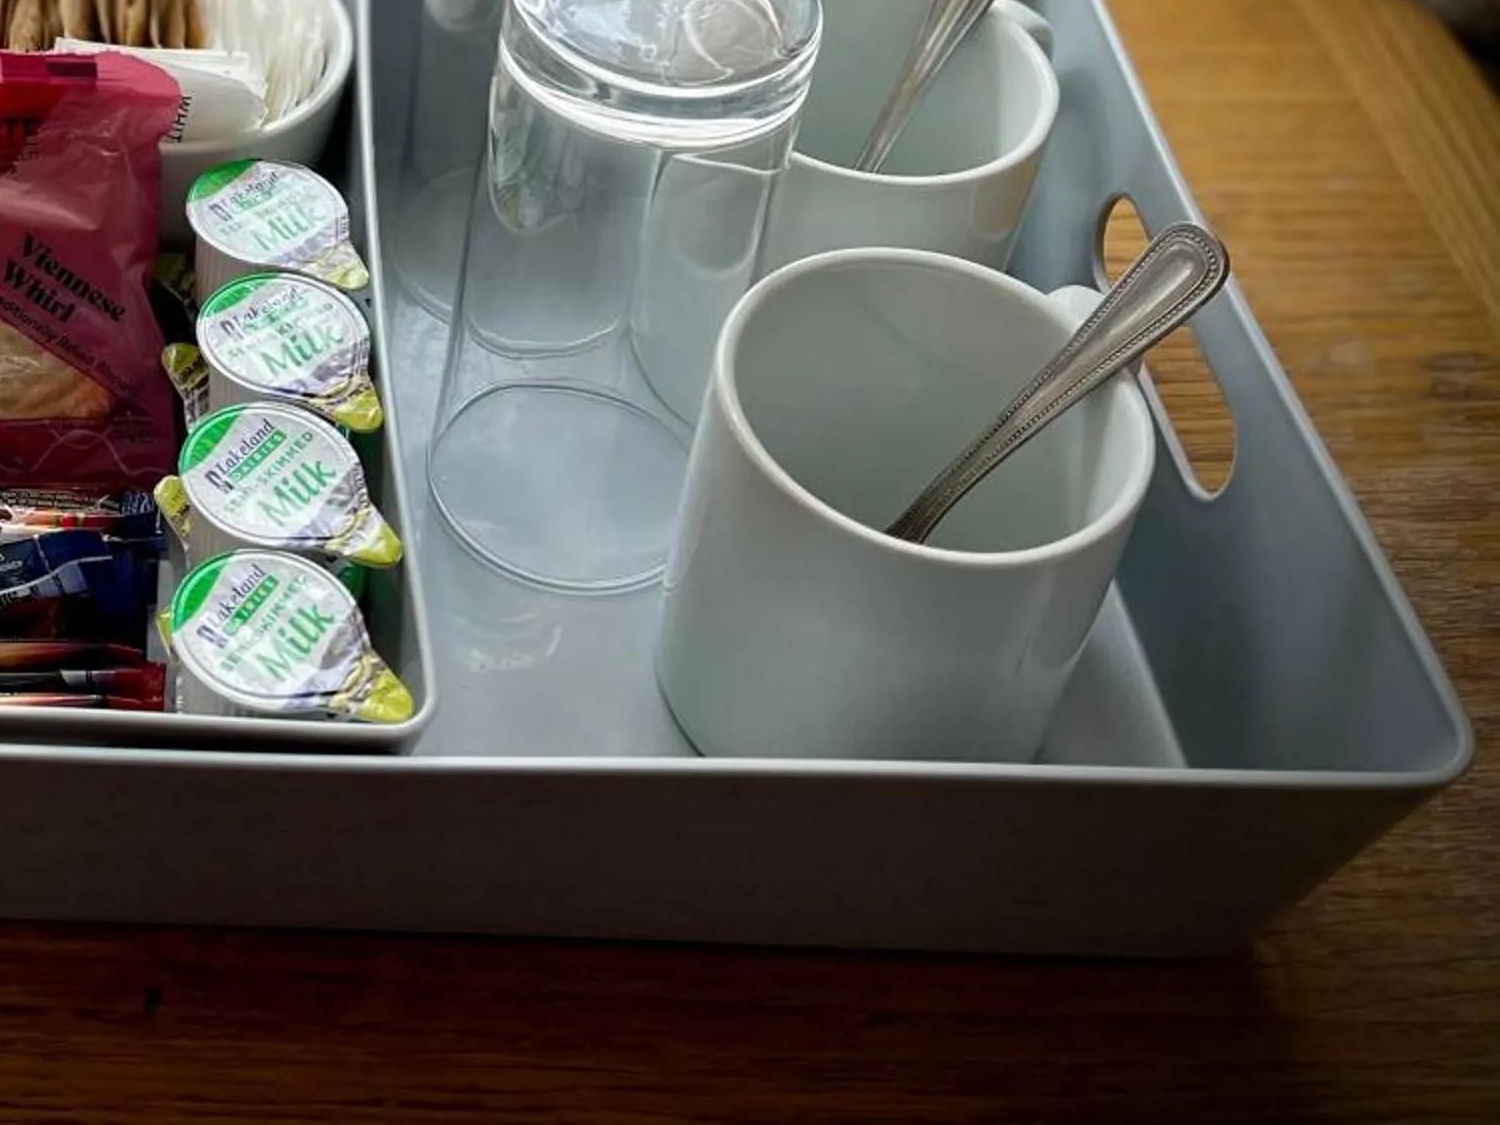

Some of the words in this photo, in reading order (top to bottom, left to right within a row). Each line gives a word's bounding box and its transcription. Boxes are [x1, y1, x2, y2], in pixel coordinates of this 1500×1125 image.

[252, 206, 327, 252] Milk
[2, 259, 77, 325] Whirl
[20, 232, 128, 323] Viennese
[259, 322, 344, 377] Milk
[215, 418, 276, 477] Lakeland
[256, 458, 336, 528] Milk
[254, 602, 336, 683] Milk
